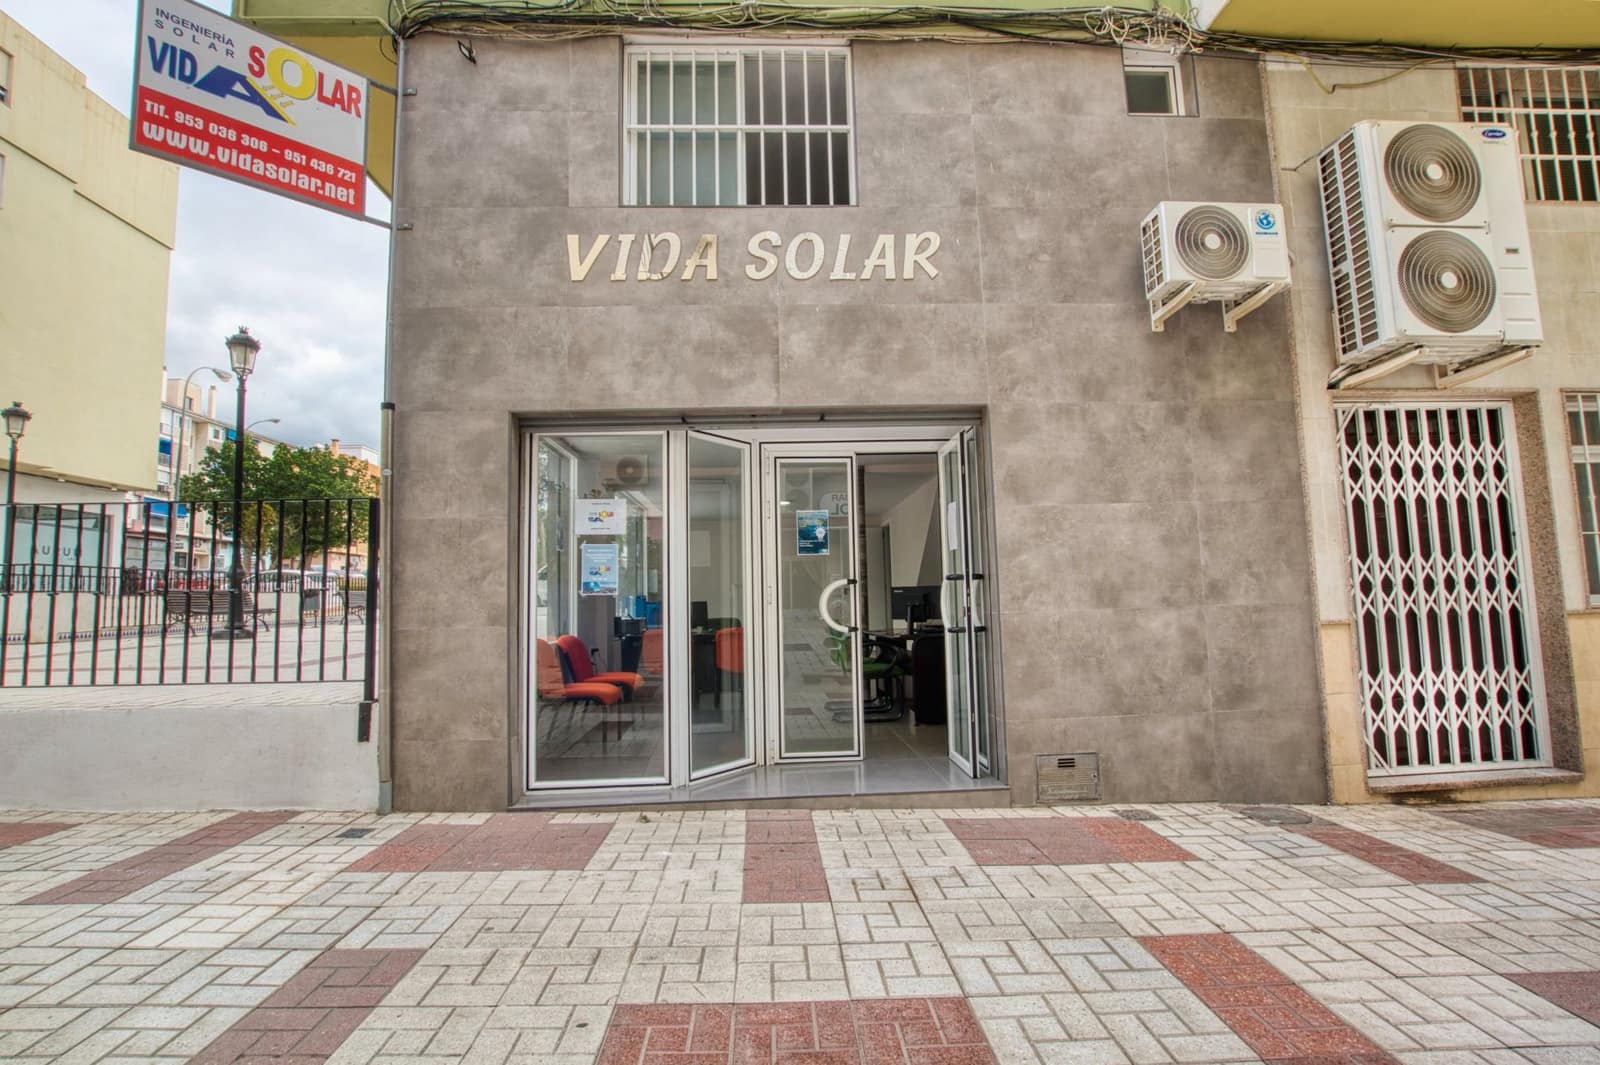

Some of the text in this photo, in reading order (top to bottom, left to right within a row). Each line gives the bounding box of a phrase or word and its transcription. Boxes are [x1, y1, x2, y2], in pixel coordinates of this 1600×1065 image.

[154, 19, 235, 59] SOLAR
[147, 35, 362, 124] VIDA SOLAR
[142, 121, 356, 206] www.vidasolar.net
[174, 110, 204, 130] 953
[241, 133, 268, 153] 306
[284, 149, 307, 166] 951
[310, 158, 334, 175] 436
[337, 167, 356, 183] 721
[566, 231, 941, 281] VIDA SOLAR
